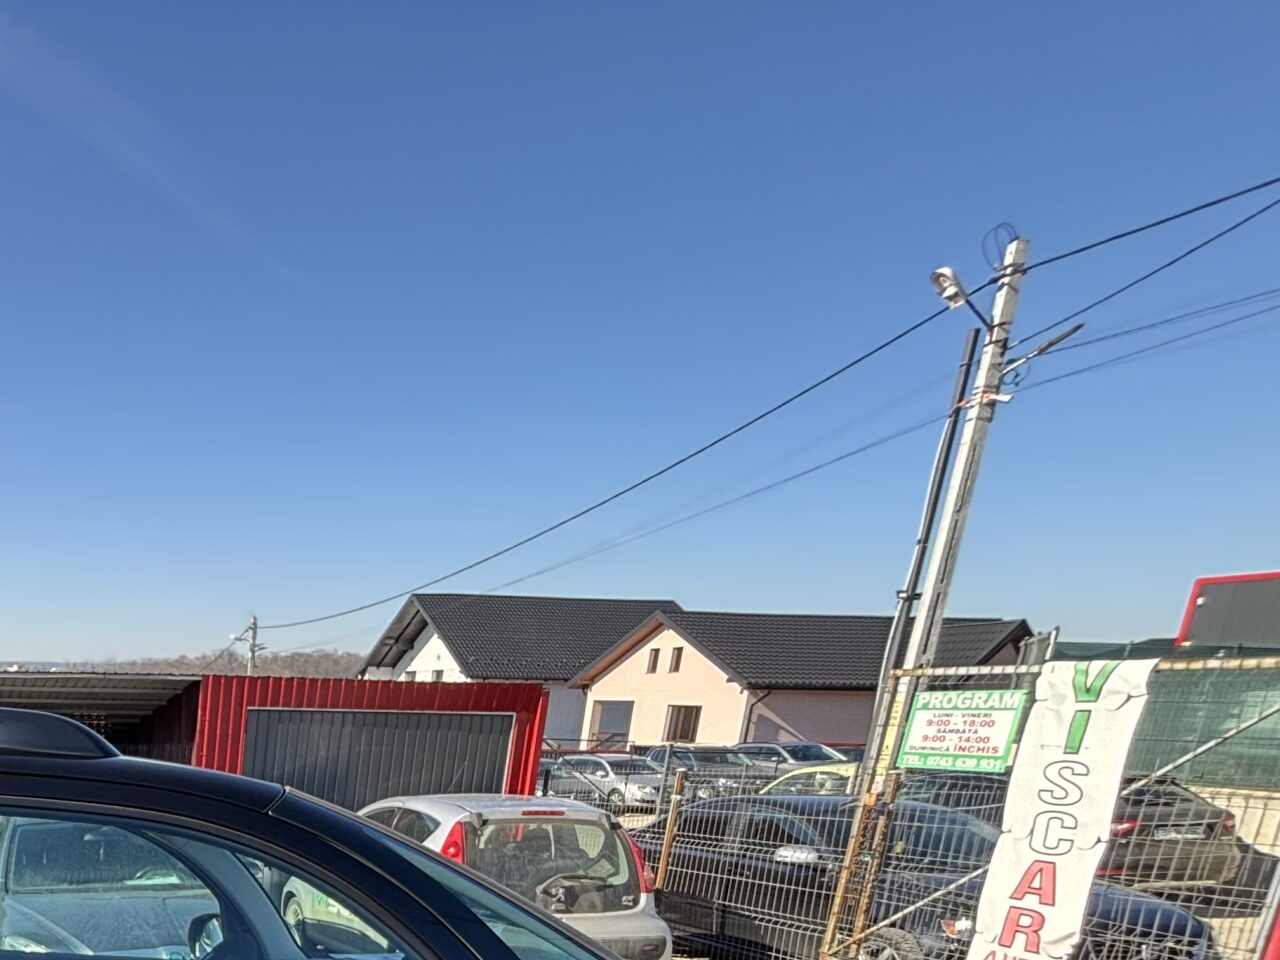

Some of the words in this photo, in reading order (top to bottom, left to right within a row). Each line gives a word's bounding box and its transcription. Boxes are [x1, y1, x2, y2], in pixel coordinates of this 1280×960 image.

[916, 692, 1021, 709] PROGRAM
[921, 734, 946, 742] 9:00
[958, 735, 991, 744] 14:00
